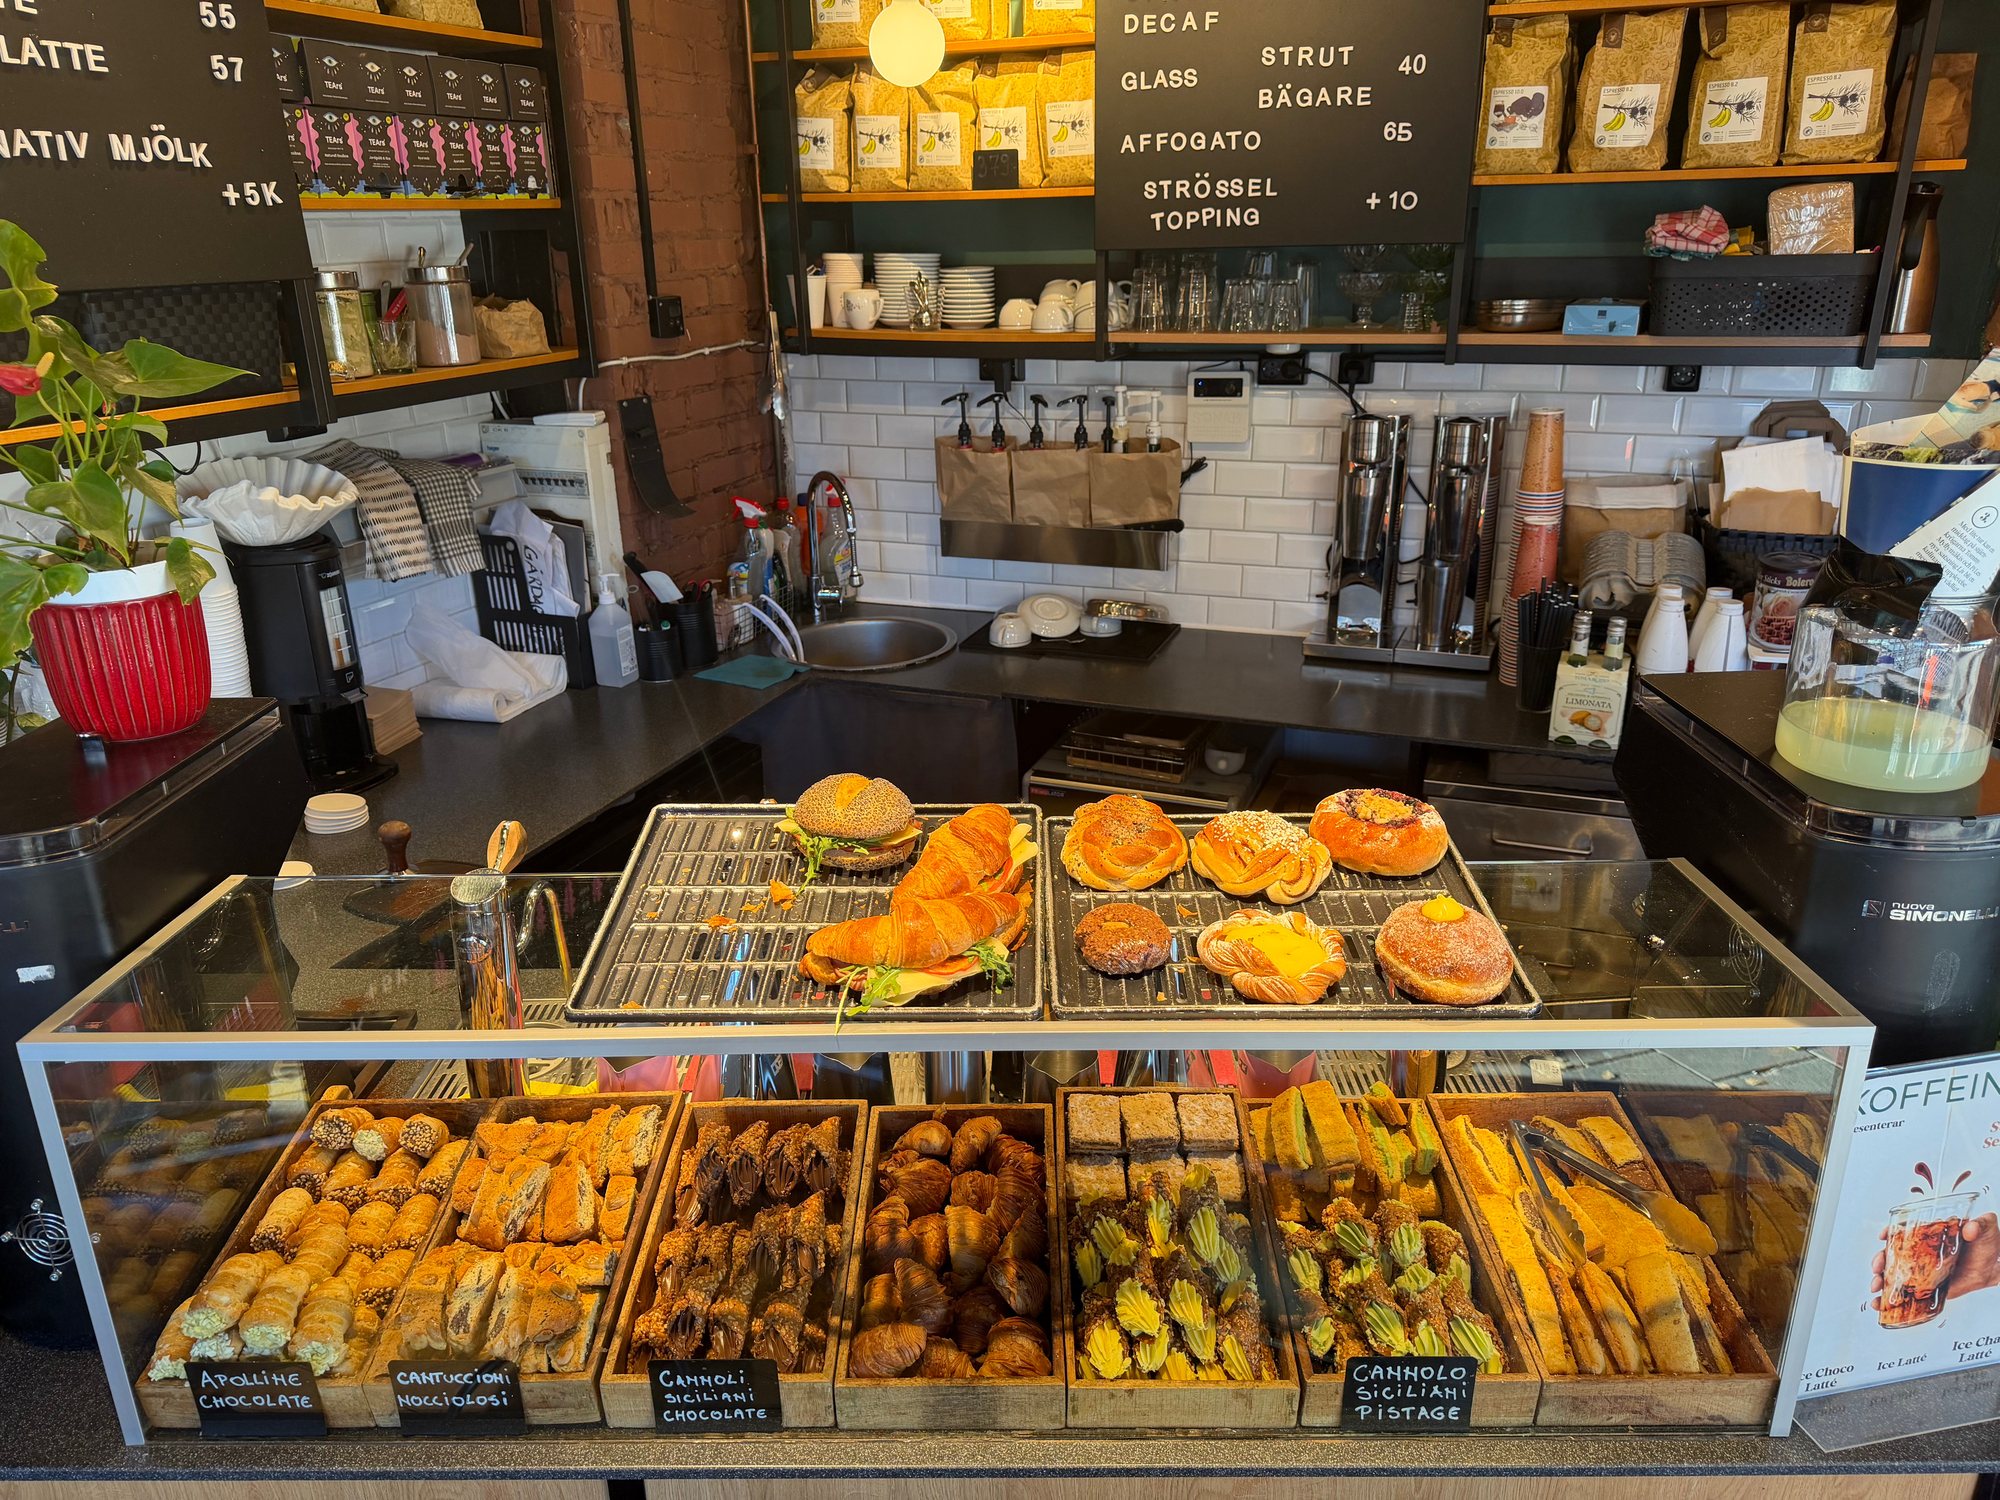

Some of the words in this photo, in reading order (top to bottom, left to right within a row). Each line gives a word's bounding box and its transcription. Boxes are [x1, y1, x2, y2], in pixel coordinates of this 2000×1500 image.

[200, 1, 236, 30] 55
[1124, 11, 1220, 34] DECAF
[0, 34, 109, 73] LATTE
[209, 54, 244, 82] 57
[1261, 45, 1354, 68] STRUT
[1397, 53, 1427, 75] 40
[1121, 68, 1198, 91] GLASS
[1258, 83, 1372, 109] BÄGARE
[108, 123, 213, 168] MJÖLK
[1120, 130, 1262, 154] AFFOGATO
[1383, 121, 1413, 142] 65
[221, 181, 284, 207] +5K
[1143, 172, 1278, 200] STRÖSSEL
[1150, 207, 1260, 231] TOPPING
[1565, 697, 1612, 709] LIMONATA
[1892, 902, 1935, 910] nuova
[1952, 1340, 1972, 1351] Ice
[1958, 1349, 1993, 1363] Latté
[1815, 1365, 1855, 1378] Choco
[1876, 1361, 1895, 1371] Ice
[1897, 1353, 1928, 1368] Latté
[1804, 1378, 1837, 1393] Latté
[199, 1394, 313, 1409] CHOCOLATE
[663, 1408, 767, 1422] CHOCOLATE
